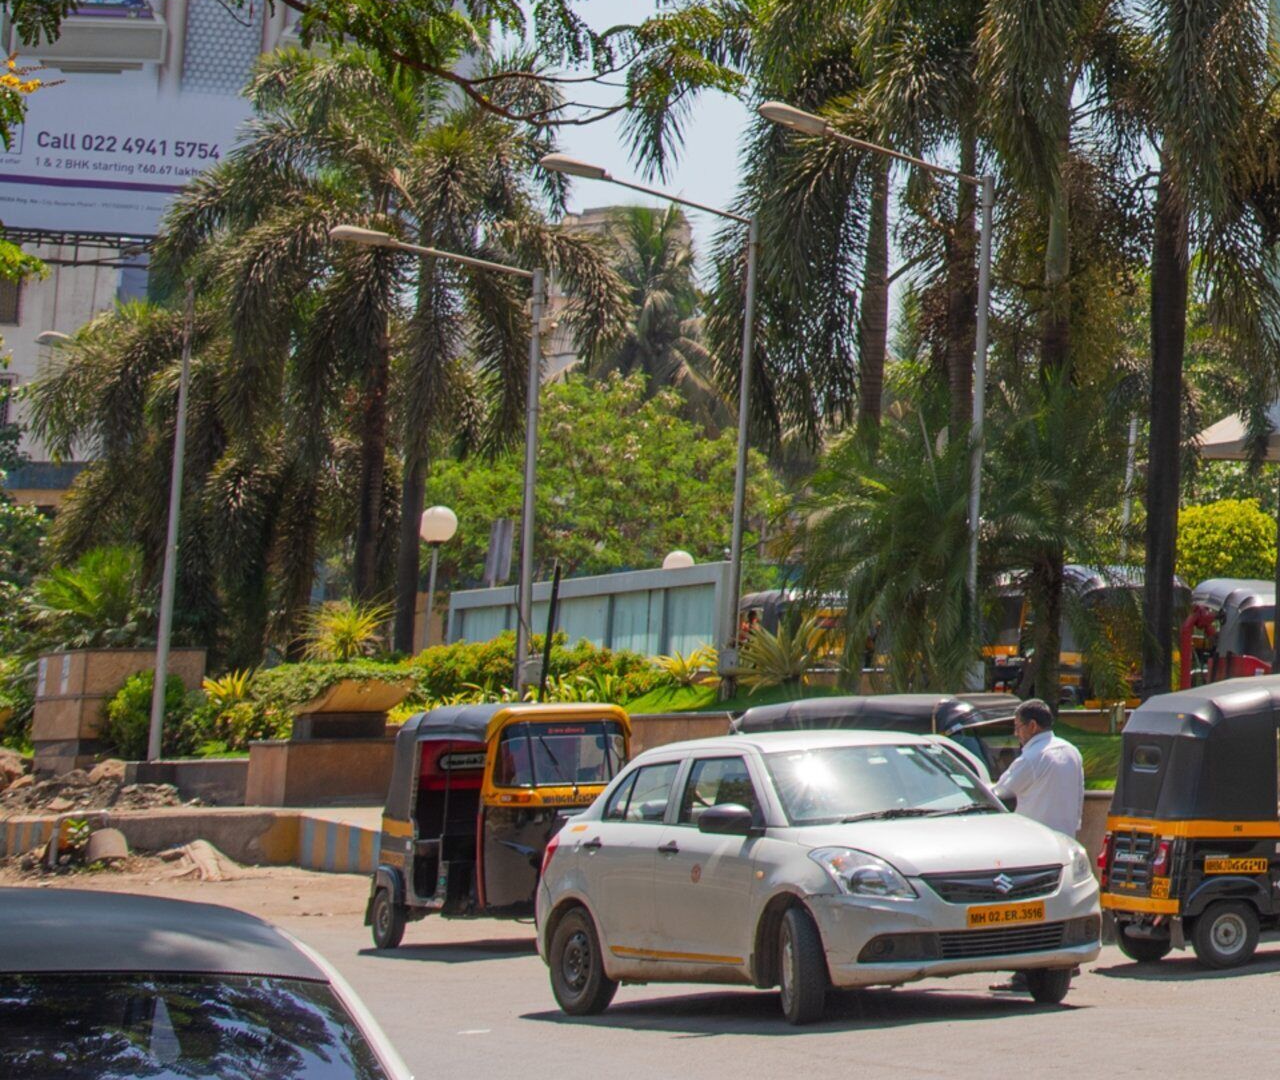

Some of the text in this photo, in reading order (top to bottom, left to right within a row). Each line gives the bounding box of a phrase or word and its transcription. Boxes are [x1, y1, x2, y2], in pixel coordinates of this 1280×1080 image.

[37, 130, 76, 151] Call
[81, 133, 117, 152] 022
[122, 137, 167, 157] 4941
[174, 140, 221, 161] 5754
[43, 157, 52, 168] &
[55, 158, 63, 169] 2
[65, 159, 90, 170] BHK
[92, 161, 135, 175] starting
